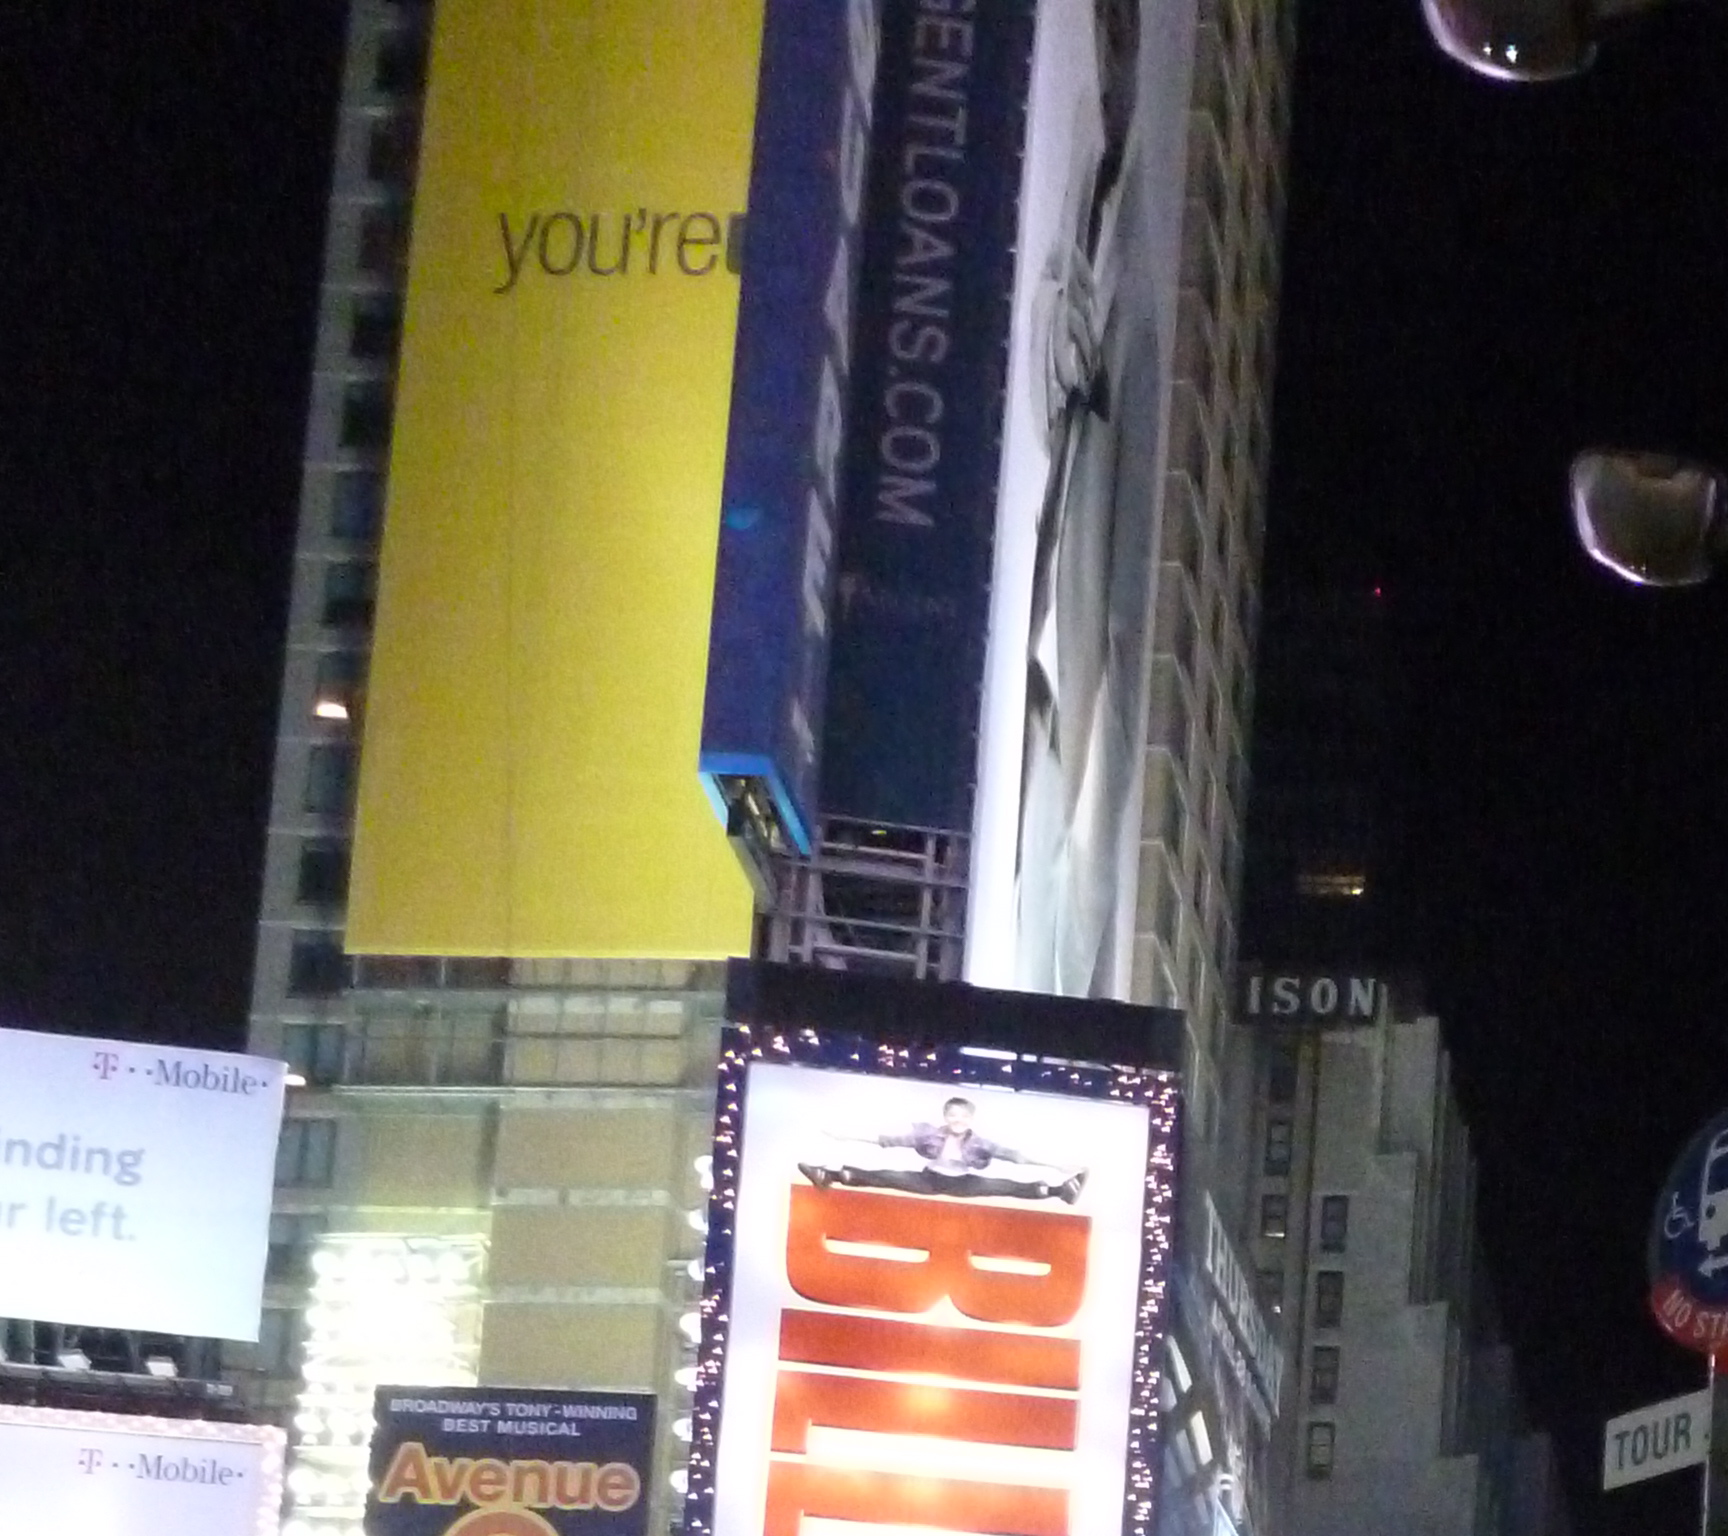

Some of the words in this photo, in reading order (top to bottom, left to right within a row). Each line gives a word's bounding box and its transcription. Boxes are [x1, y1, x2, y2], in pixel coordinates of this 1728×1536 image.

[493, 207, 721, 293] you're
[1663, 1288, 1692, 1328] NO
[442, 1417, 491, 1434] BEST
[497, 1420, 581, 1437] MUSICAL
[1614, 1411, 1692, 1471] TOUR
[379, 1441, 641, 1513] Avenue
